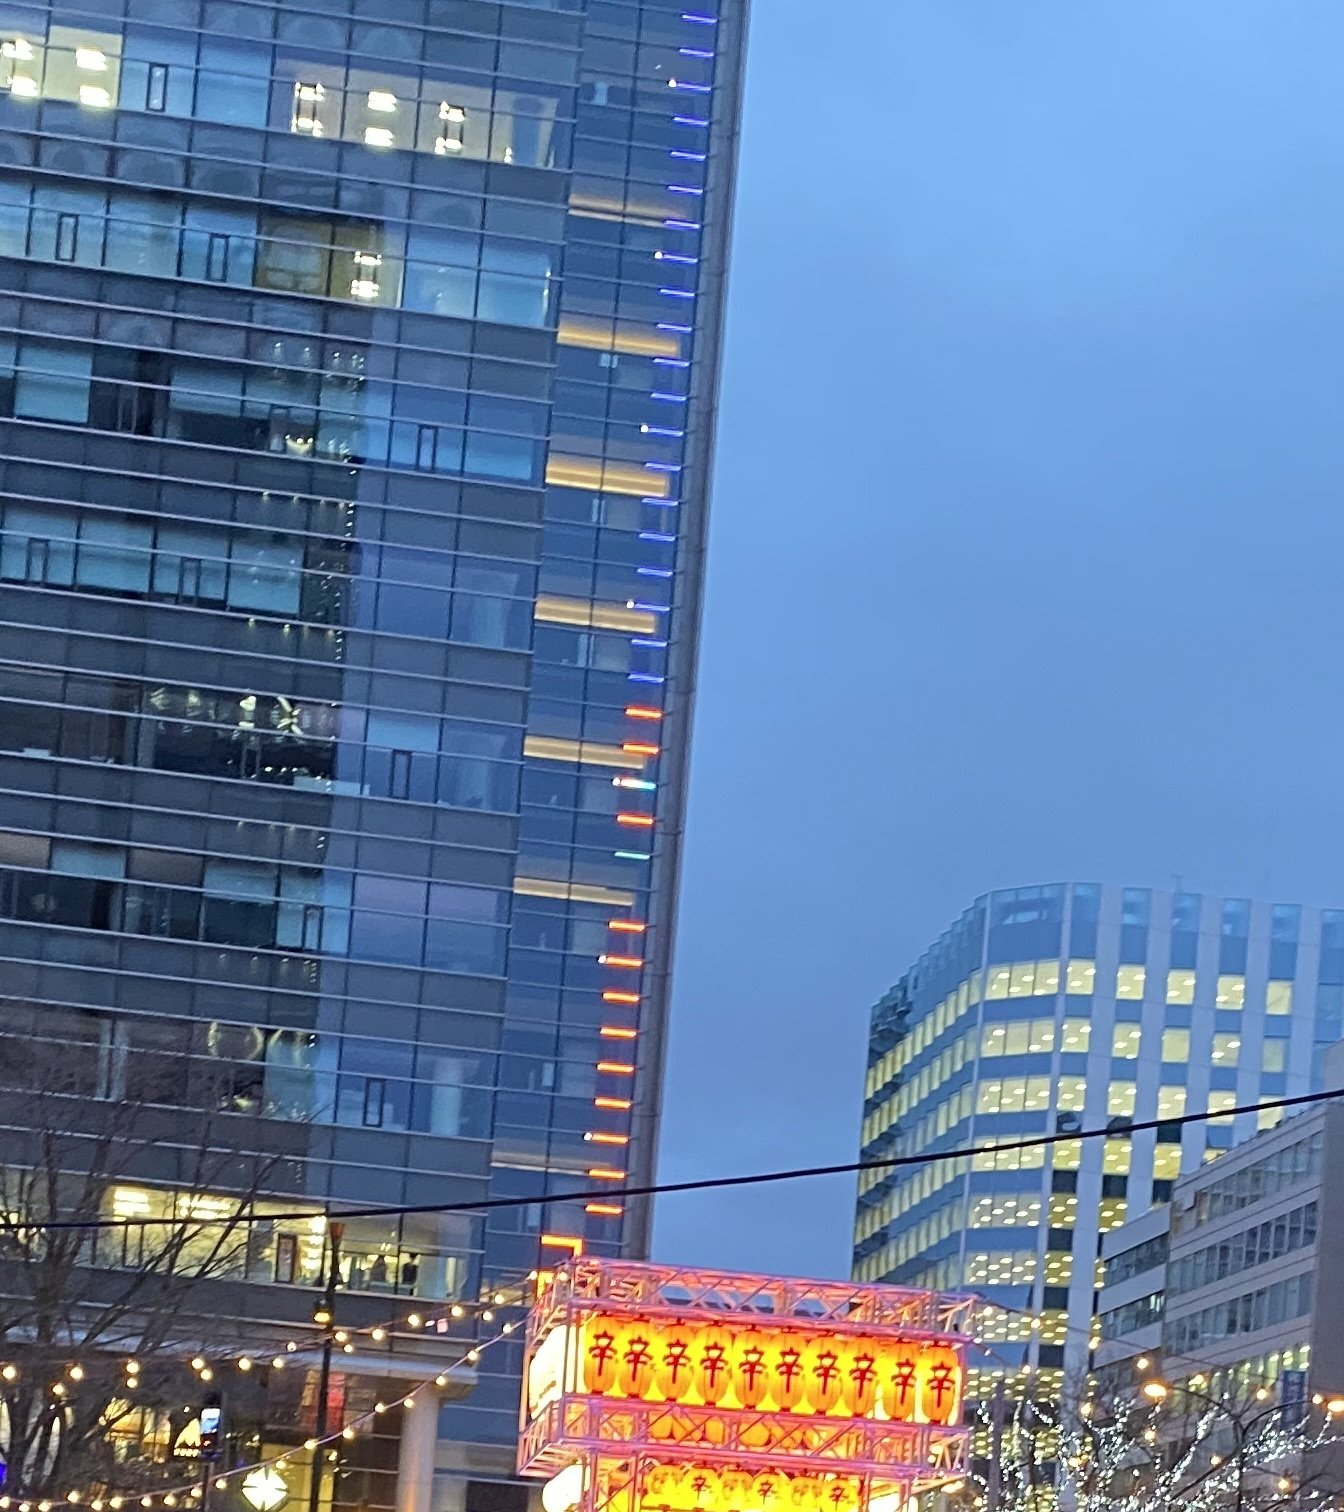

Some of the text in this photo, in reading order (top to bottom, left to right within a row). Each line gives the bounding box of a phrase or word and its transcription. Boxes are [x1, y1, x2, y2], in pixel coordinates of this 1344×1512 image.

[589, 1330, 956, 1408] 辛 辛 辛 辛 辛 辛 辛 辛 辛 辛
